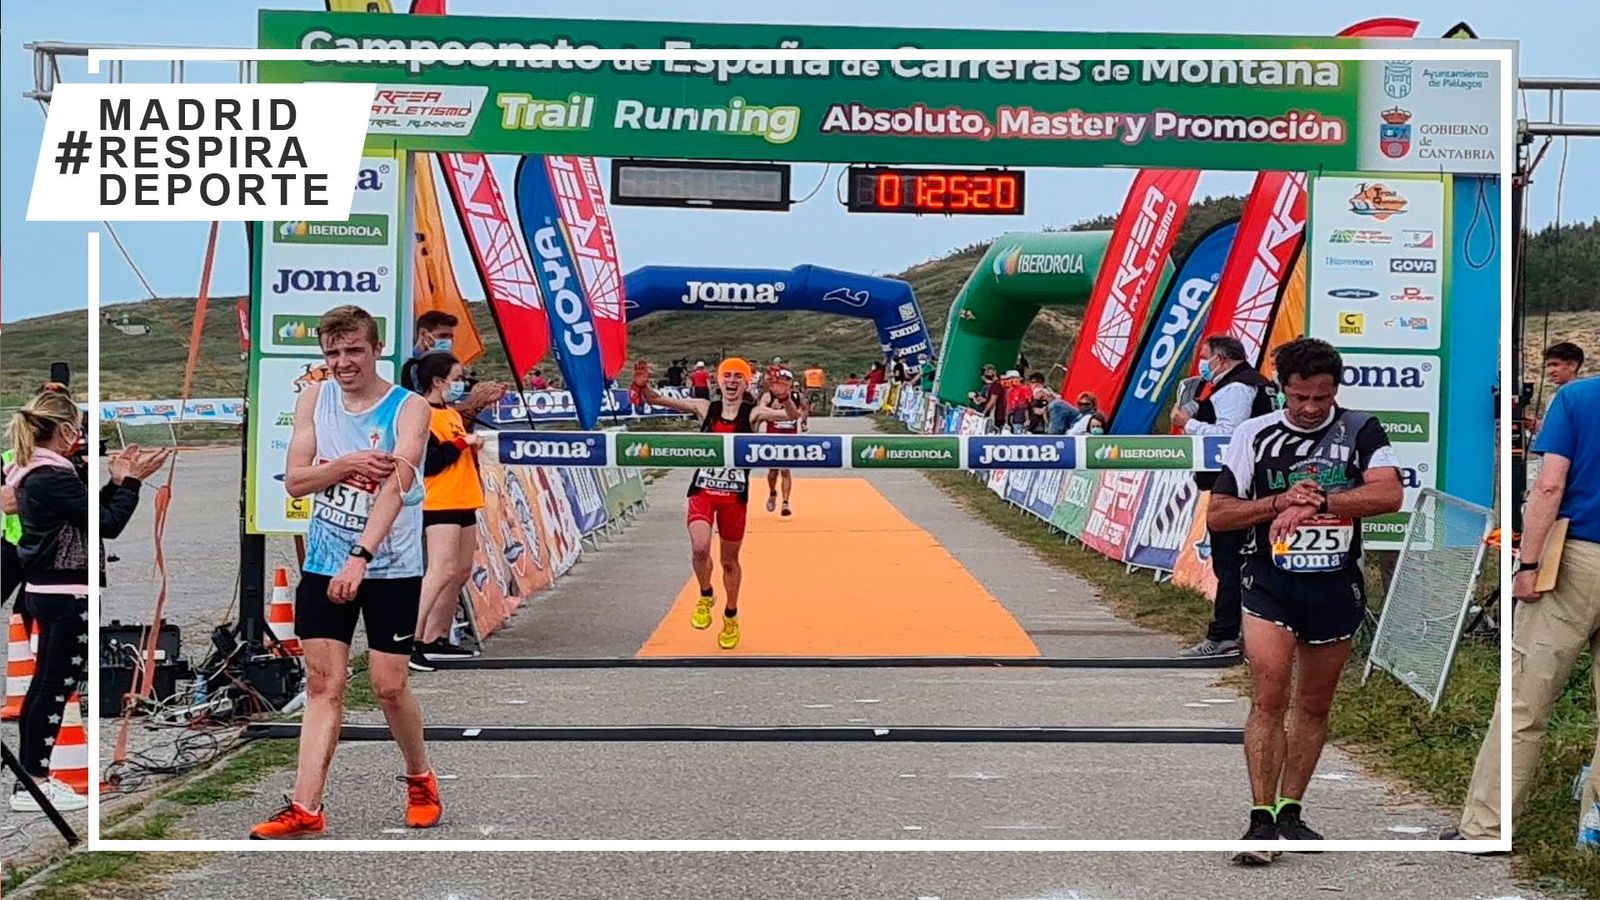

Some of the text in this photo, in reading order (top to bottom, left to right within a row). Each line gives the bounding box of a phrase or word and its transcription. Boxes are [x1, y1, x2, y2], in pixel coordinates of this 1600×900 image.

[301, 31, 601, 72] Campeonato
[664, 41, 831, 81] España
[841, 57, 880, 77] de
[890, 46, 1082, 81] Carreras
[1093, 60, 1130, 80] de
[1422, 68, 1489, 80] Ayuntamiento
[504, 97, 1342, 142] Trail Running Absoluto, Master y Promoción
[1420, 124, 1489, 135] GOBIERNO
[1419, 136, 1432, 147] de
[1419, 148, 1495, 160] CANTABRIA
[308, 225, 383, 237] IBERDROLA
[1017, 252, 1085, 274] IBERDROLA
[1340, 365, 1425, 388] oma
[650, 447, 718, 458] IBERDROLA
[886, 449, 953, 460] IBERDROLA
[1119, 448, 1186, 460] IBERDROLA
[324, 484, 360, 513] 451
[1288, 528, 1341, 551] 225
